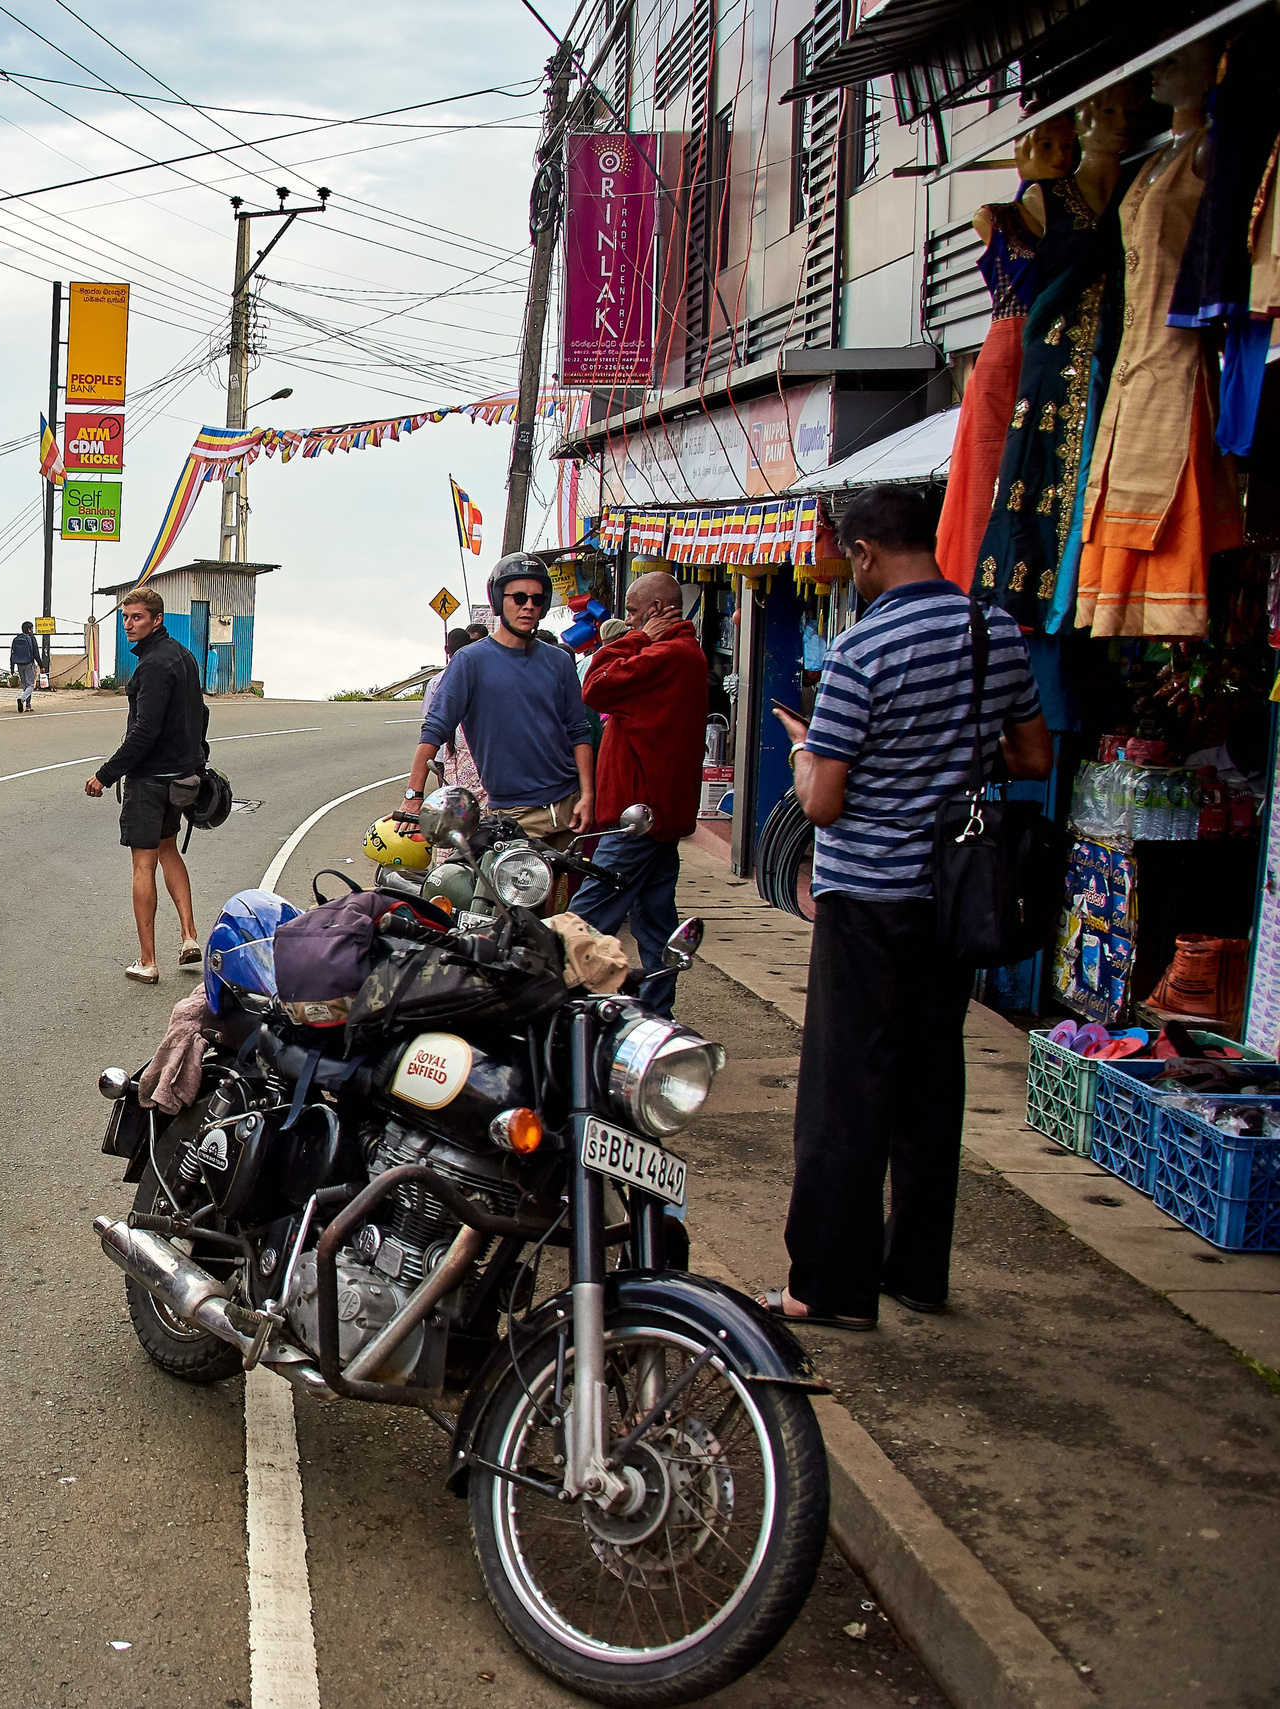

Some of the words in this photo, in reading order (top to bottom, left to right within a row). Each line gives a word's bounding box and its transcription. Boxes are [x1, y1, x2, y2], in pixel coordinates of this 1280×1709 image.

[618, 264, 627, 329] CENTRE
[71, 374, 122, 386] PEOPLE'S
[70, 385, 96, 393] BANK
[76, 427, 111, 441] ATM
[68, 440, 105, 455] CDM
[765, 442, 787, 463] PAINT
[80, 454, 119, 465] KIOSK
[68, 489, 103, 507] Self
[78, 506, 116, 517] Banking
[414, 1050, 447, 1069] ROYAL
[407, 1062, 448, 1085] ENFIELD
[587, 1140, 607, 1162] SP
